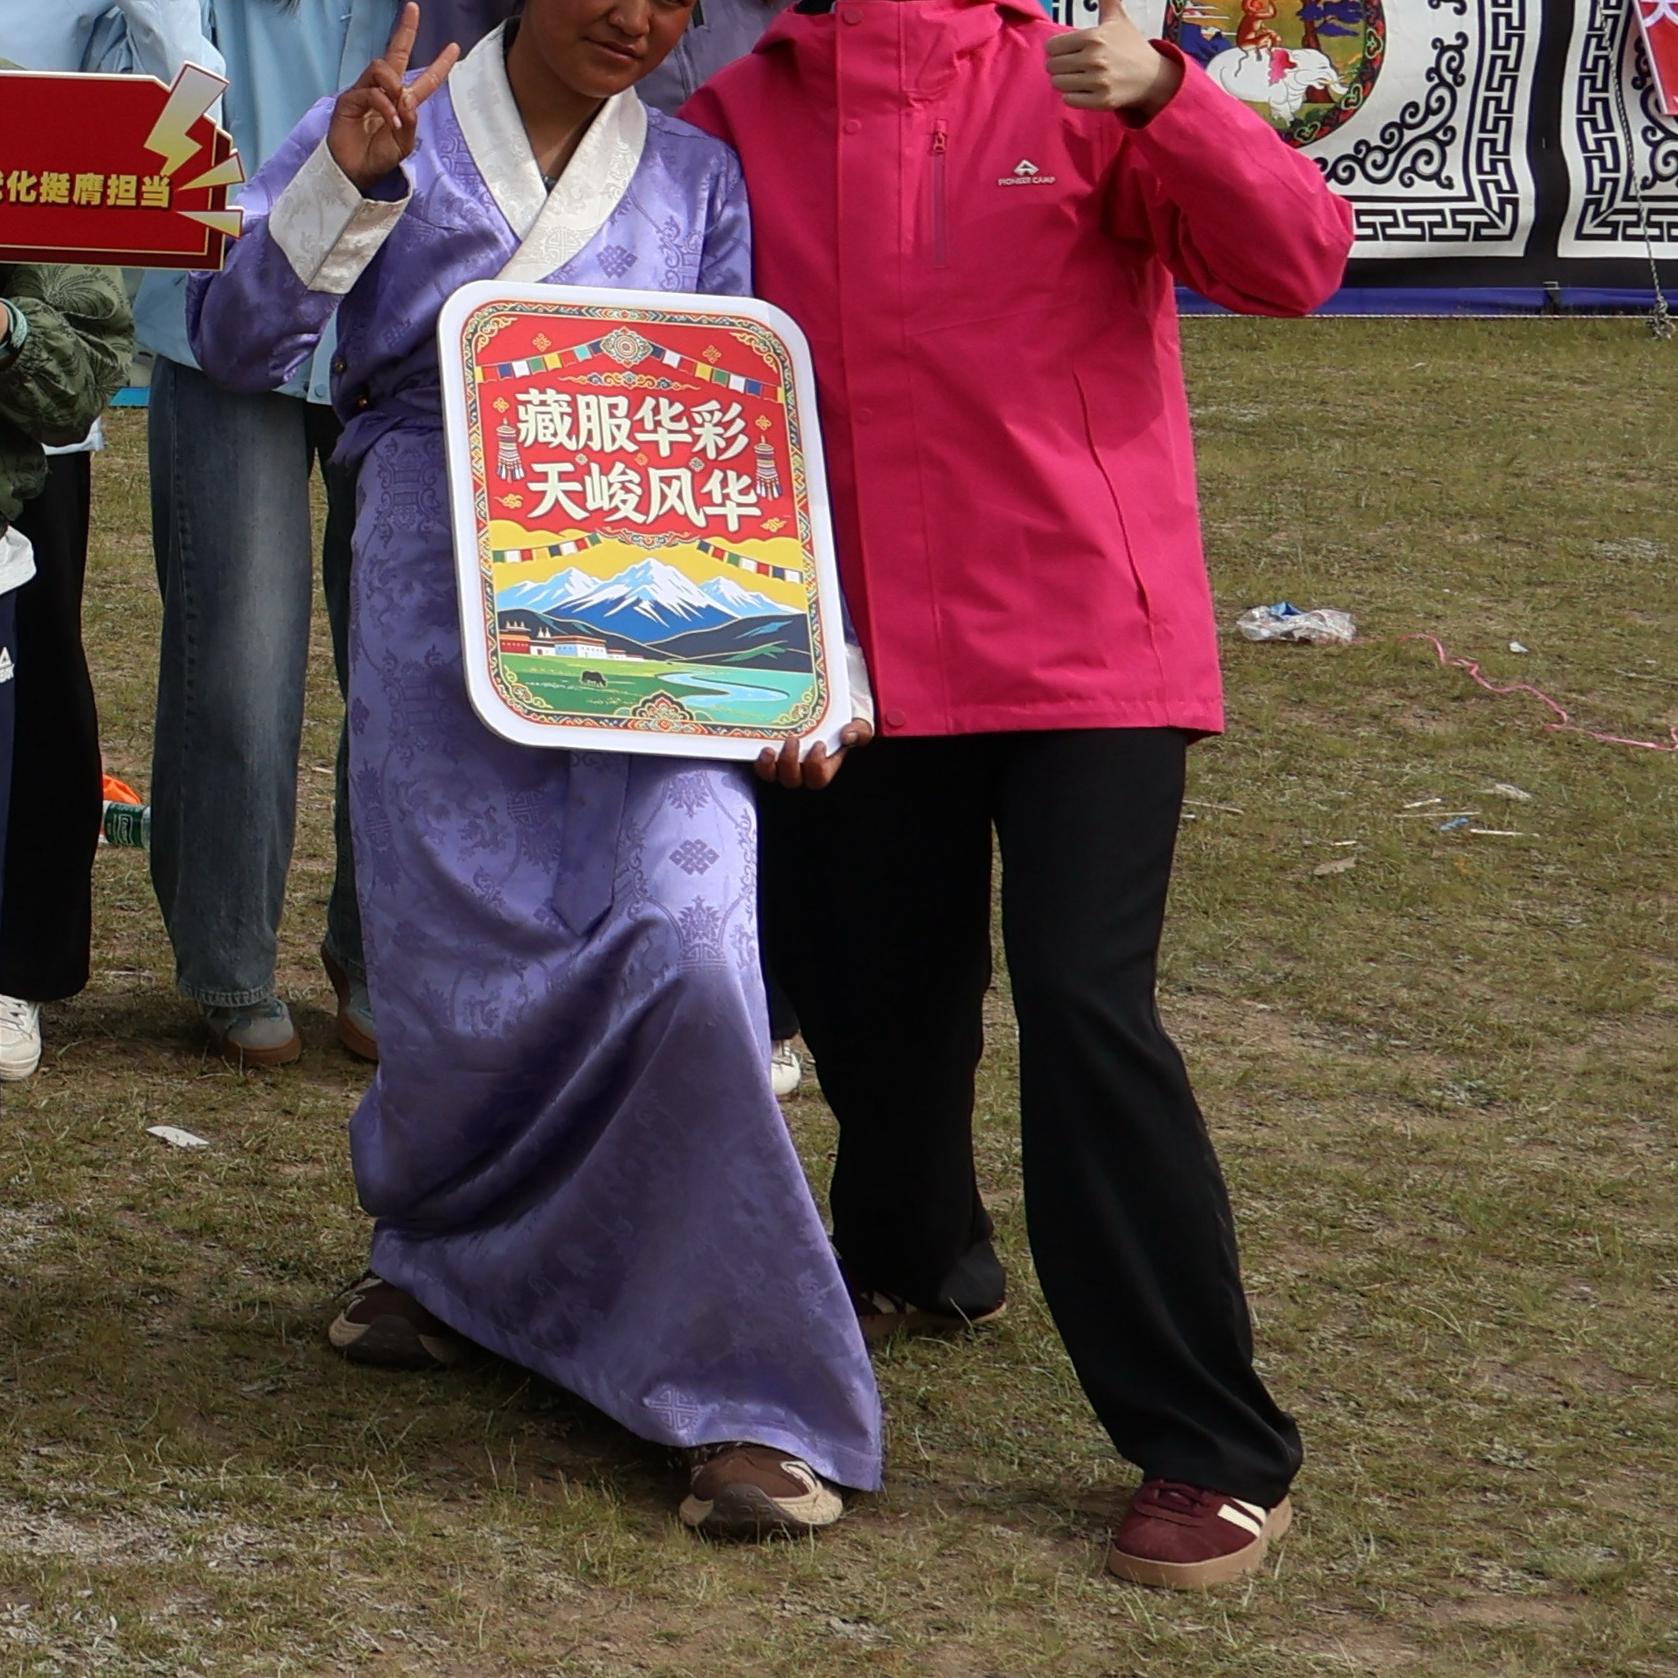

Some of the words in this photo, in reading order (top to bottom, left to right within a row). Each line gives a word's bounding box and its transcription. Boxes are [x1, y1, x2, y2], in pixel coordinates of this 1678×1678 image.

[998, 177, 1031, 186] PIONEER
[1032, 176, 1056, 184] CAMP
[516, 387, 747, 461] 藏服华彩
[526, 462, 763, 532] 天峻风华
